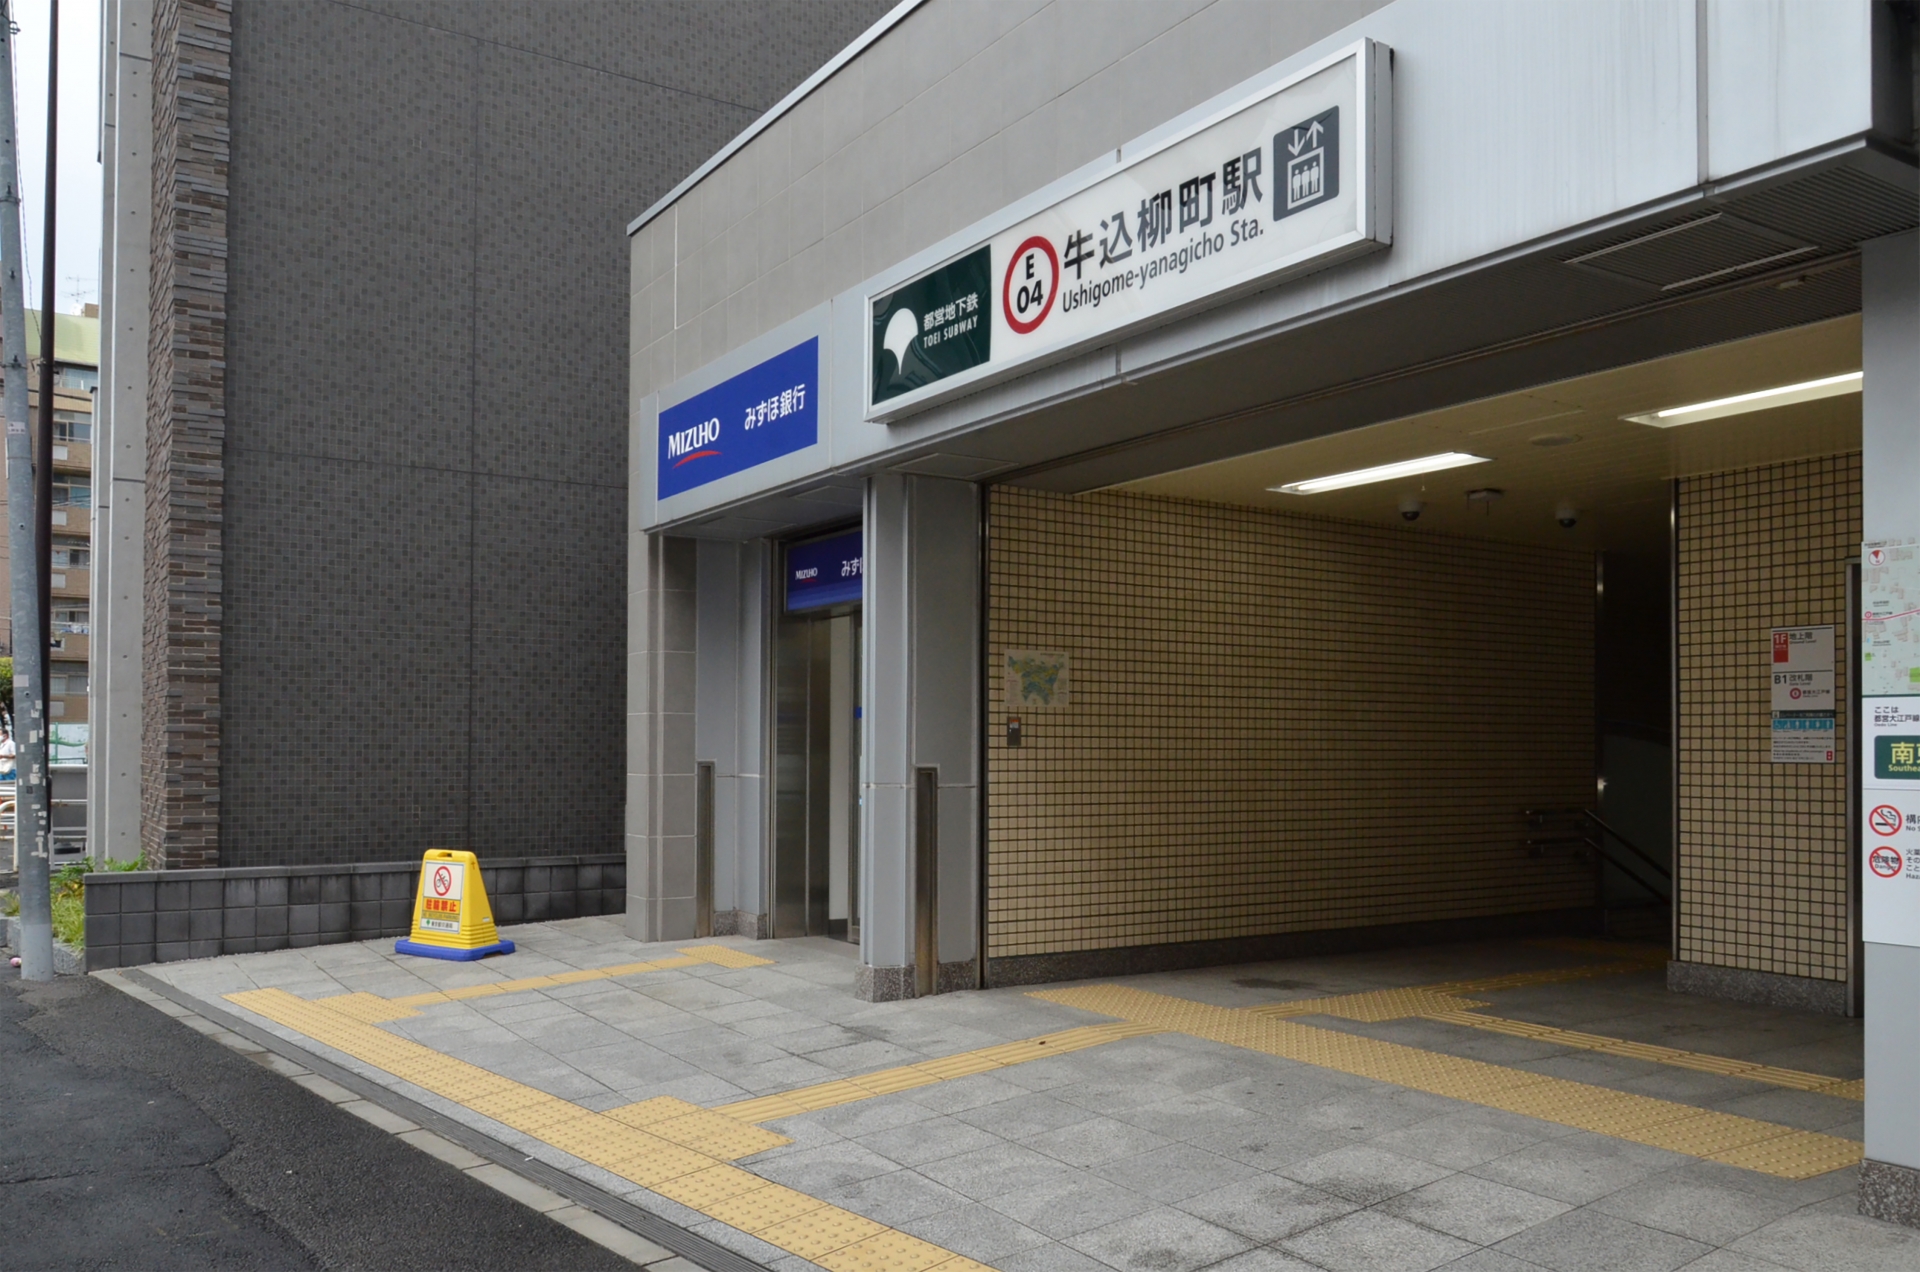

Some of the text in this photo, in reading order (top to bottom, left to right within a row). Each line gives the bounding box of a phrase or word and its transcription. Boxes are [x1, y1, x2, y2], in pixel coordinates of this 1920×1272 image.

[1064, 147, 1263, 280] 牛込柳町駅
[1025, 254, 1034, 279] E
[1063, 217, 1264, 312] Ushigome-yanagicho Sta.
[1017, 280, 1043, 314] 04
[924, 292, 978, 331] 都営地下鉄
[924, 315, 978, 348] TOEI SUBWAY
[744, 384, 805, 430] みずほ銀行
[668, 418, 720, 459] MIZUHO
[795, 567, 818, 580] MIZUHO
[1774, 634, 1787, 644] 1F
[1789, 632, 1813, 640] 地上階
[1774, 675, 1787, 684] B1
[1789, 674, 1813, 682] 改札階
[1874, 706, 1899, 714] ここは
[1874, 714, 1920, 722] 都営大江戸線
[1890, 741, 1920, 764] 南
[1873, 855, 1899, 865] 危険物
